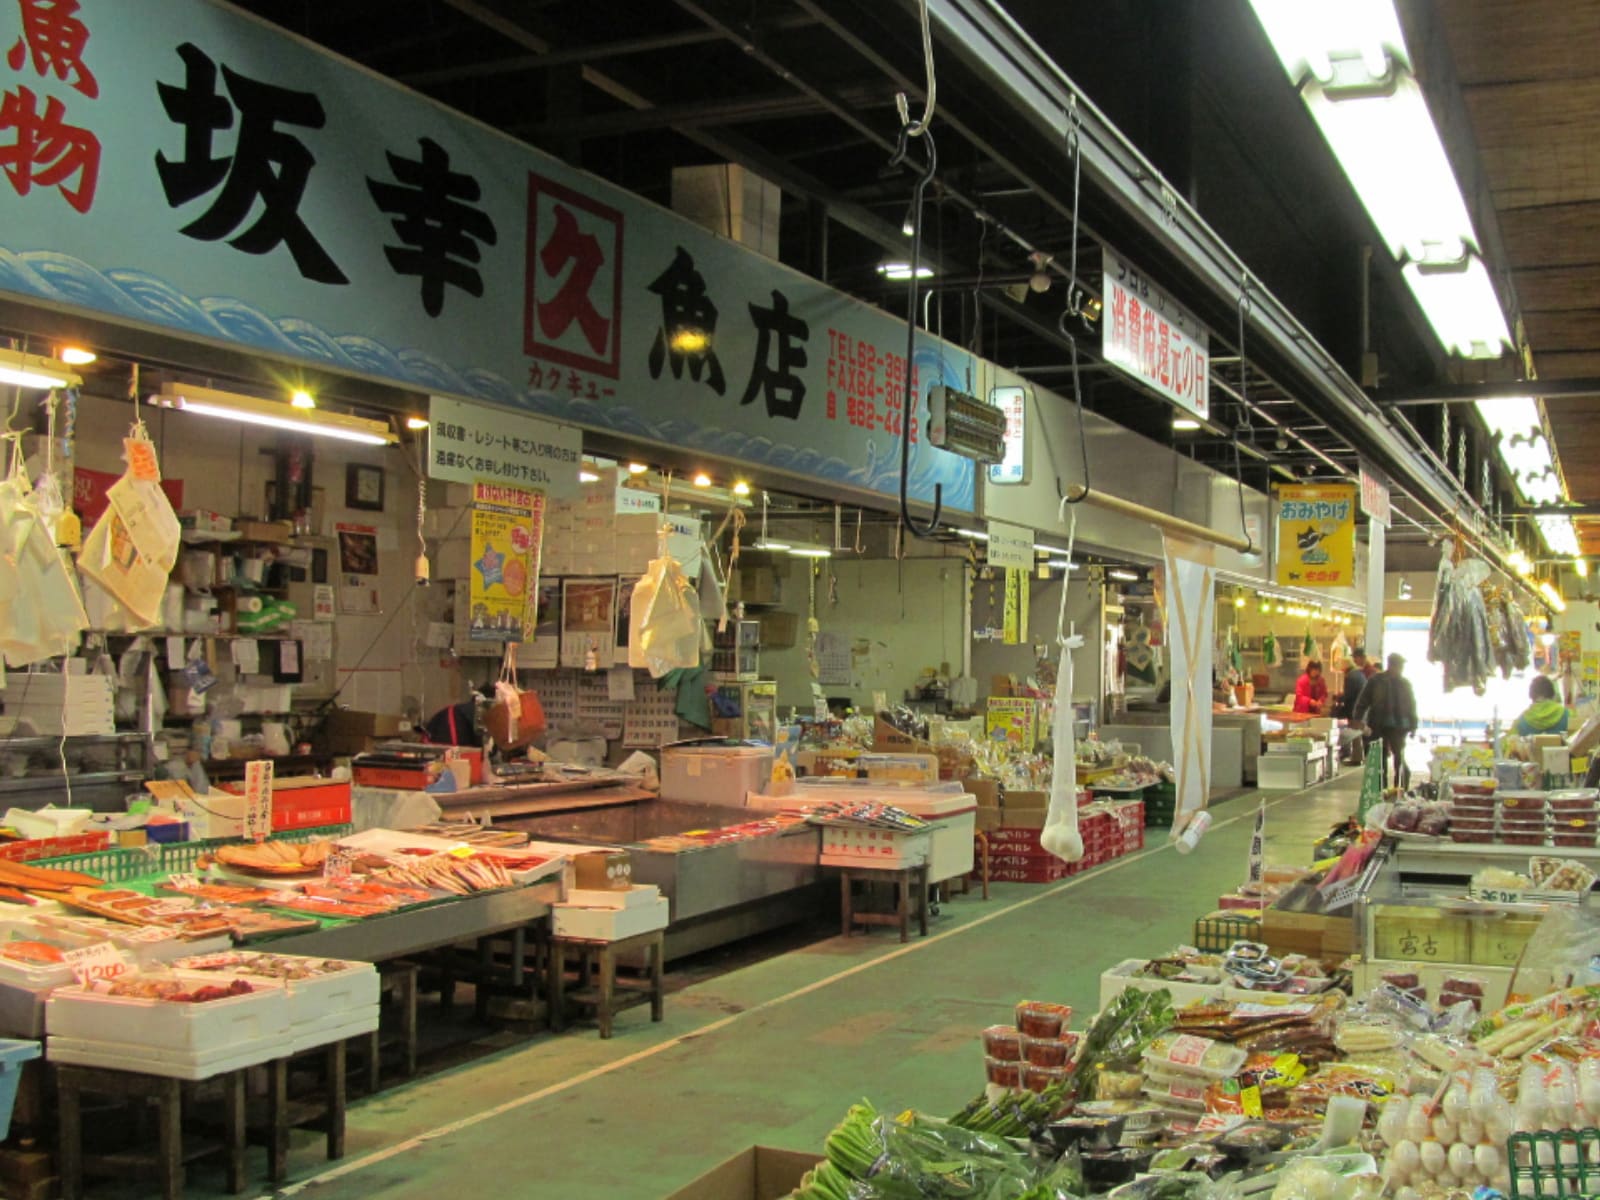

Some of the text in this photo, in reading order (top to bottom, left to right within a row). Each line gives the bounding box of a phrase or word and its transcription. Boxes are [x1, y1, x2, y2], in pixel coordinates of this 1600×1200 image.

[526, 361, 617, 400] カクキュー
[1280, 499, 1350, 521] おみやげ
[1398, 928, 1440, 957] 宮古
